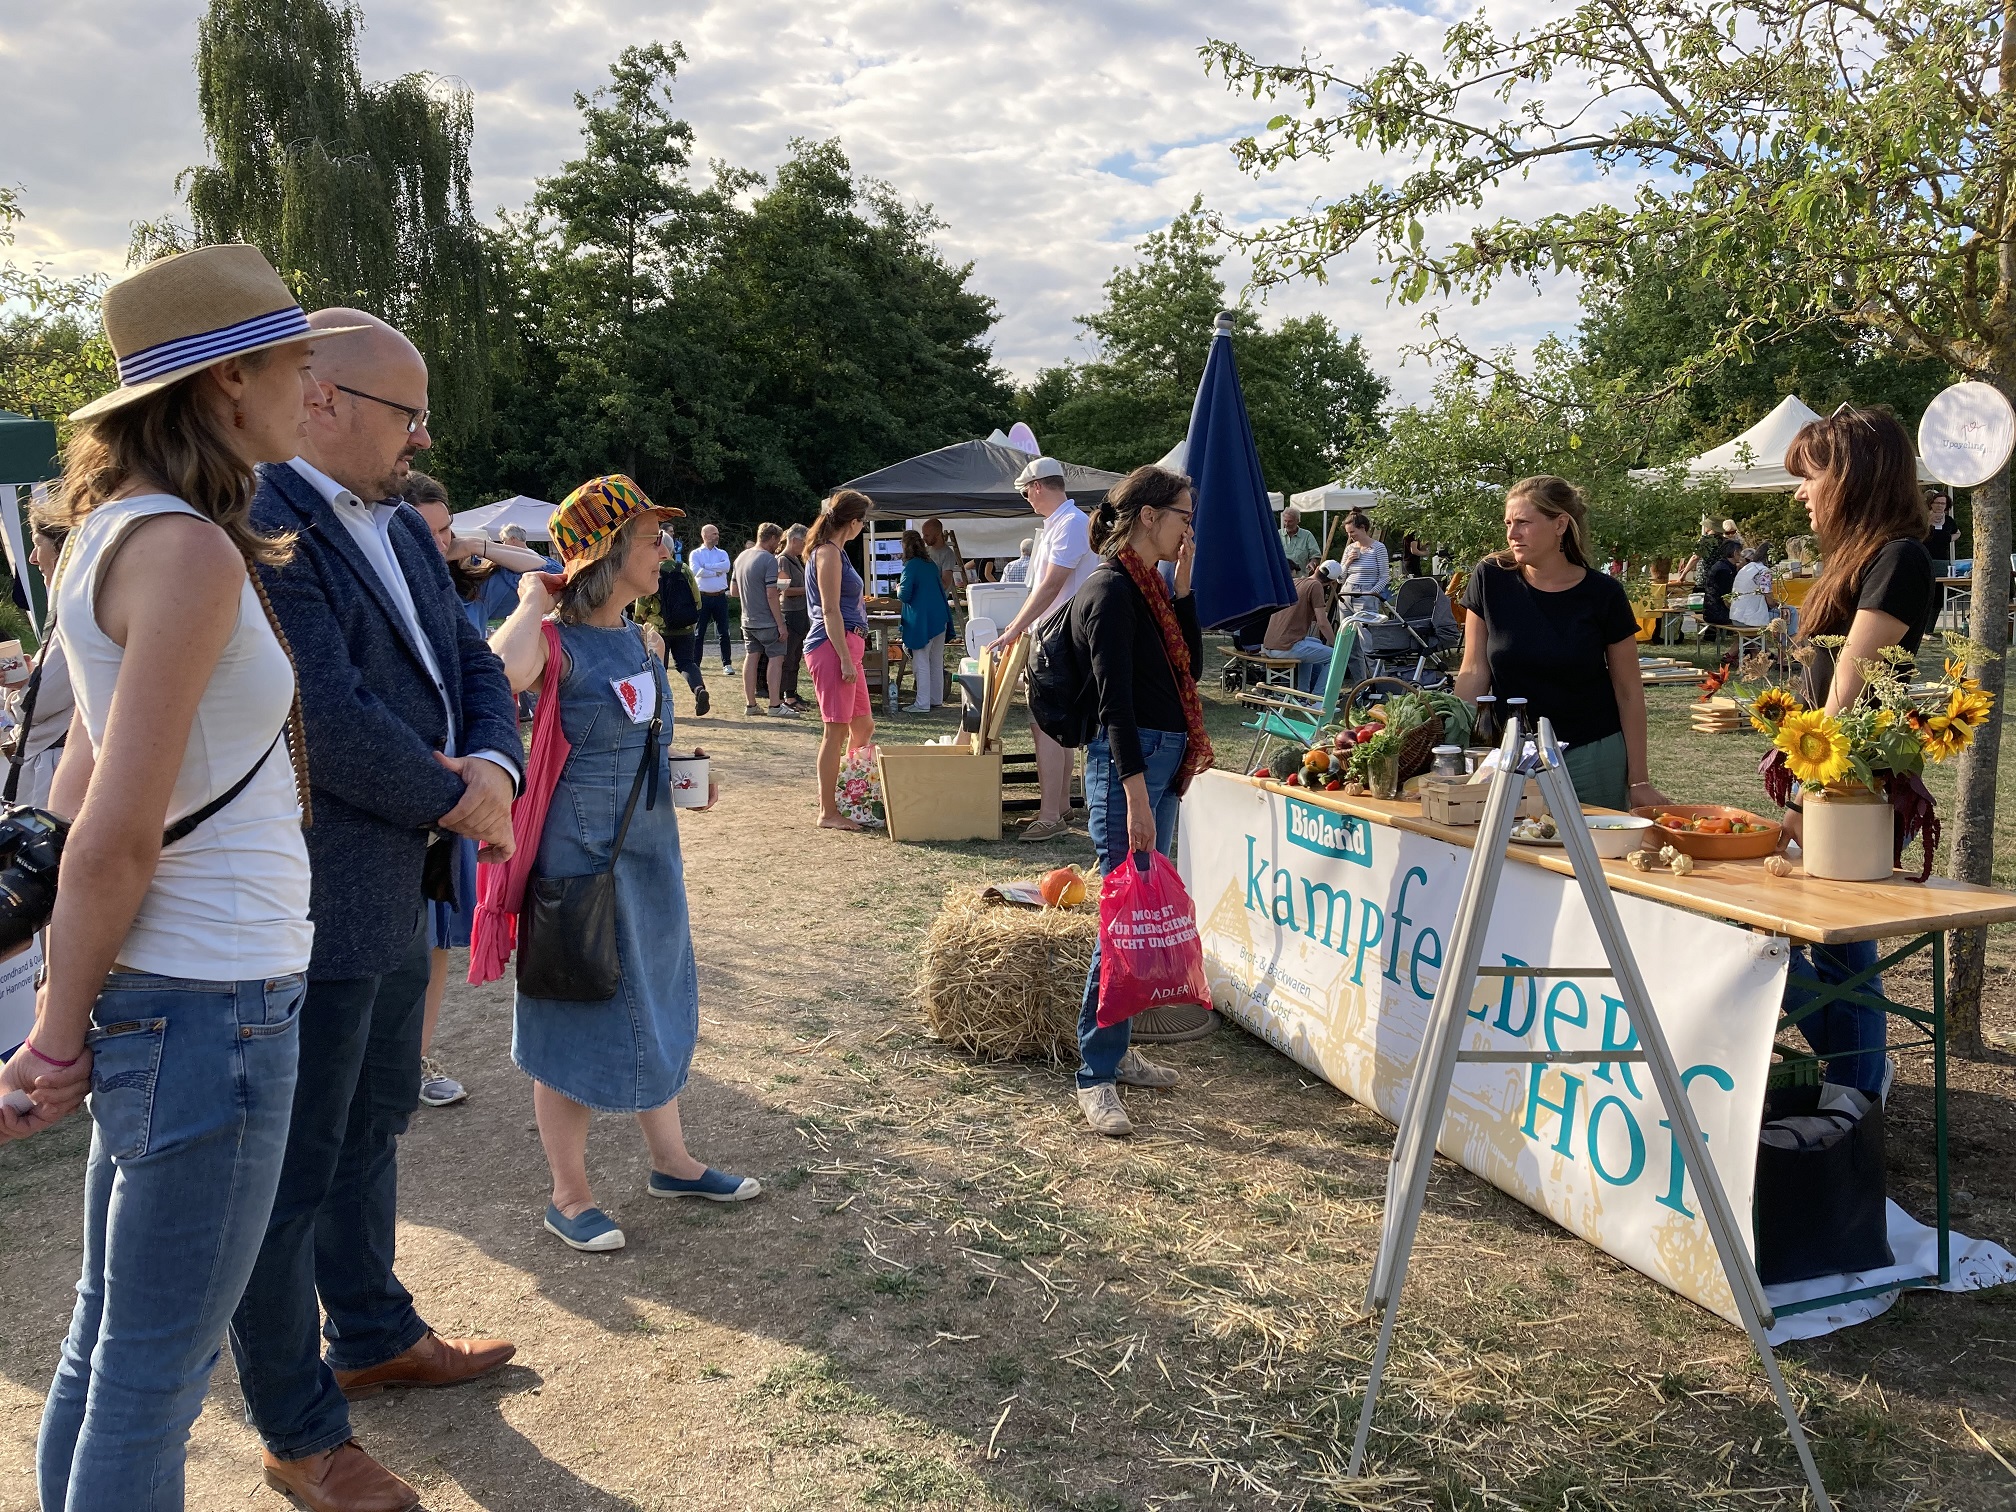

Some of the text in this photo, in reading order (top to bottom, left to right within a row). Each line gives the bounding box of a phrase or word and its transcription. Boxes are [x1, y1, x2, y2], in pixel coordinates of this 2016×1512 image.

[1290, 803, 1366, 856] Bioland
[16, 857, 38, 874] Nikon
[6, 974, 34, 995] Hannover
[1240, 946, 1311, 999] Brot- & Backwaren
[1151, 984, 1190, 1001] ADLER
[1262, 992, 1270, 1007] &
[1271, 999, 1292, 1021] Obst
[1265, 1028, 1295, 1057] Fleisch
